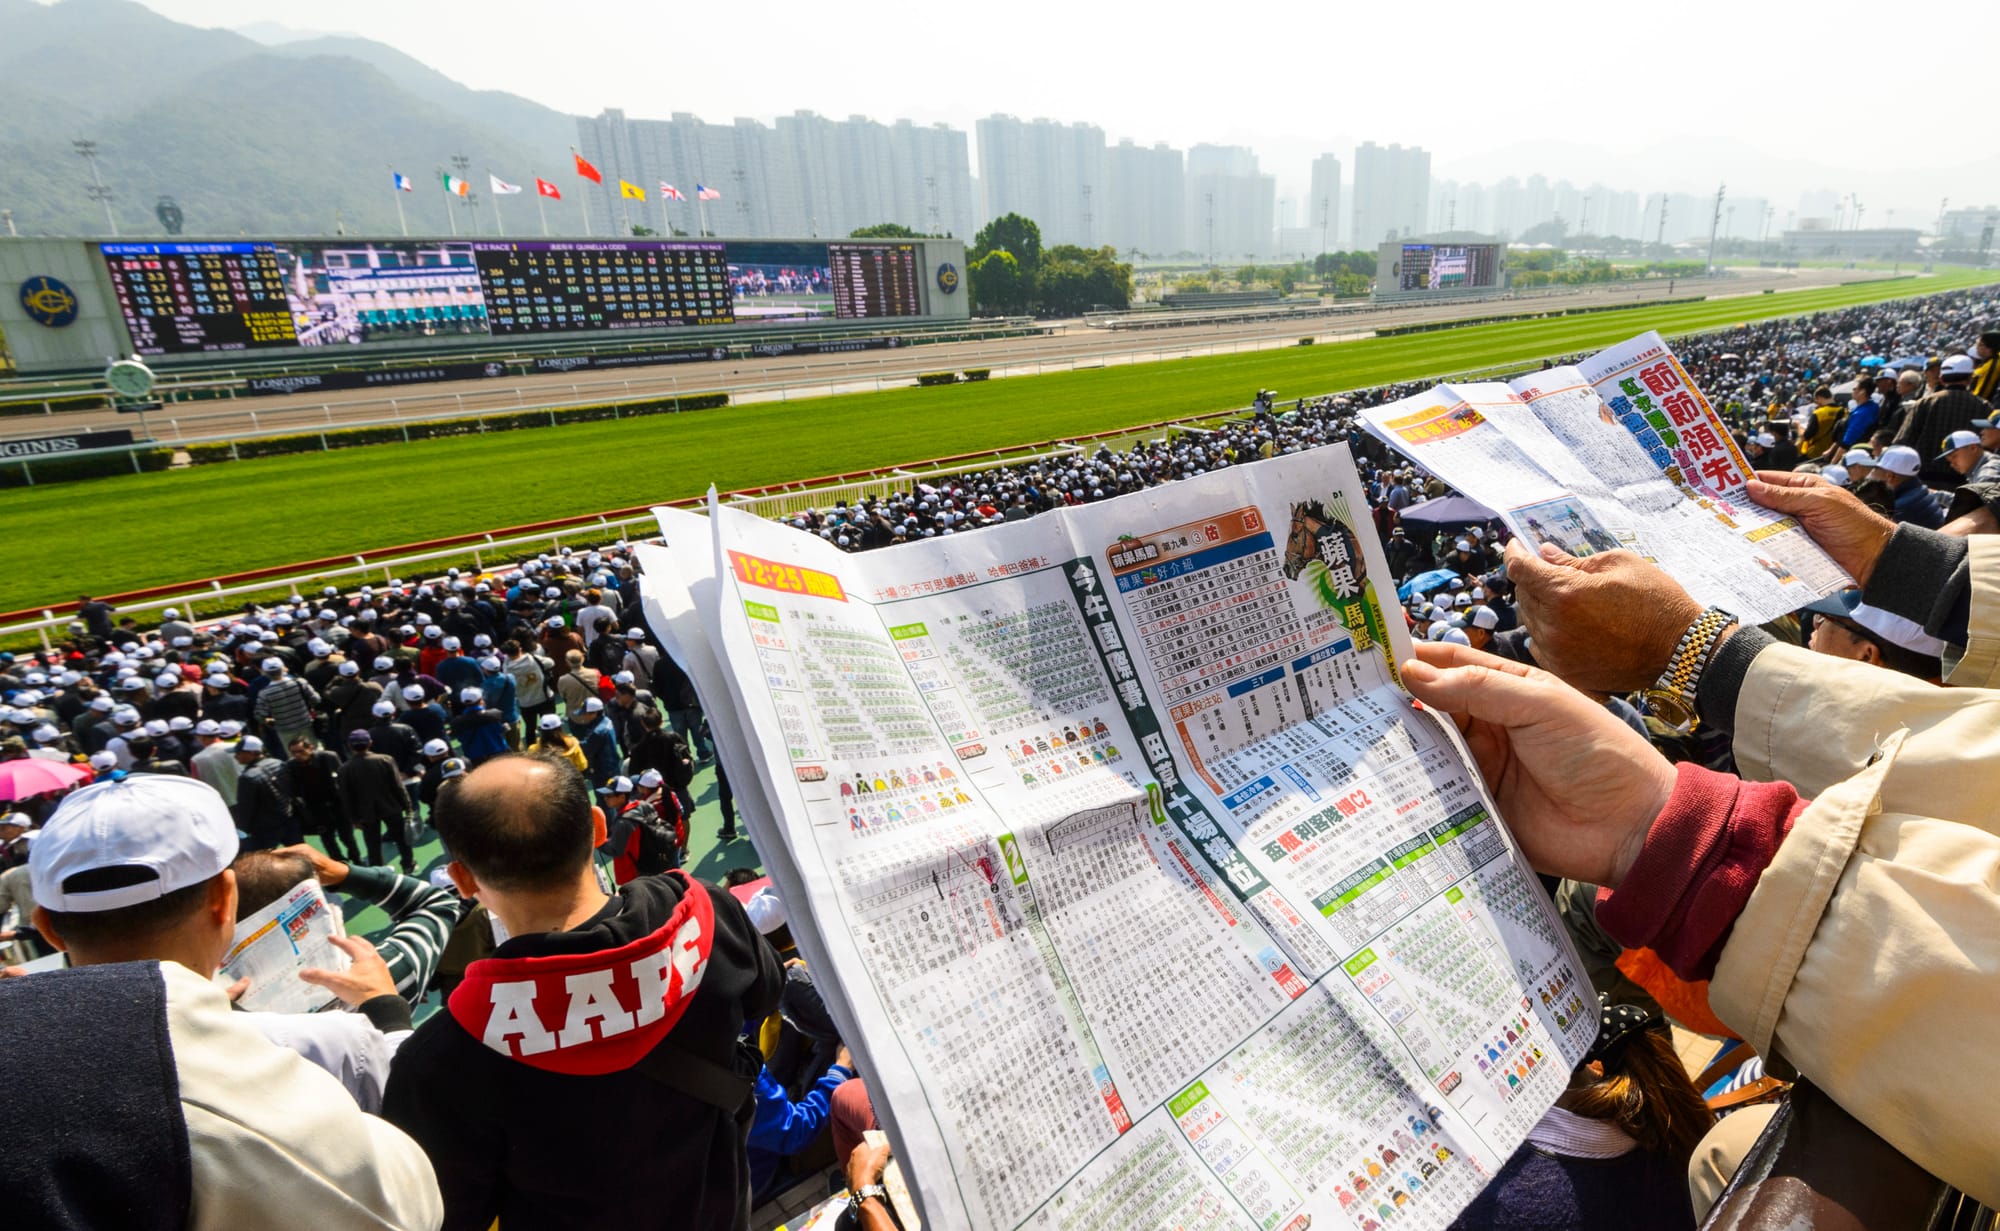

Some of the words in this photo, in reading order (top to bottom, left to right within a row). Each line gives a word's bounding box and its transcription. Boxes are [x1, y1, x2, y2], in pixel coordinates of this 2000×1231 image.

[225, 260, 239, 268] 11
[538, 356, 590, 369] LONGINES
[251, 376, 323, 391] LONGINES
[1639, 361, 1742, 492] 節節領先
[0, 438, 80, 458] GINES
[1332, 490, 1344, 500] D1
[1161, 536, 1189, 552] 第九場
[738, 556, 803, 592] 12:25
[1156, 557, 1195, 579] 好介紹
[1318, 531, 1360, 601] 蘋果
[1071, 562, 1147, 713] 今午國際賽
[1344, 601, 1375, 653] 馬經
[1371, 602, 1386, 631] APPLE
[1380, 631, 1393, 661] HORSE
[1140, 731, 1262, 894] 田草十場排位
[483, 916, 708, 1057] AAPE
